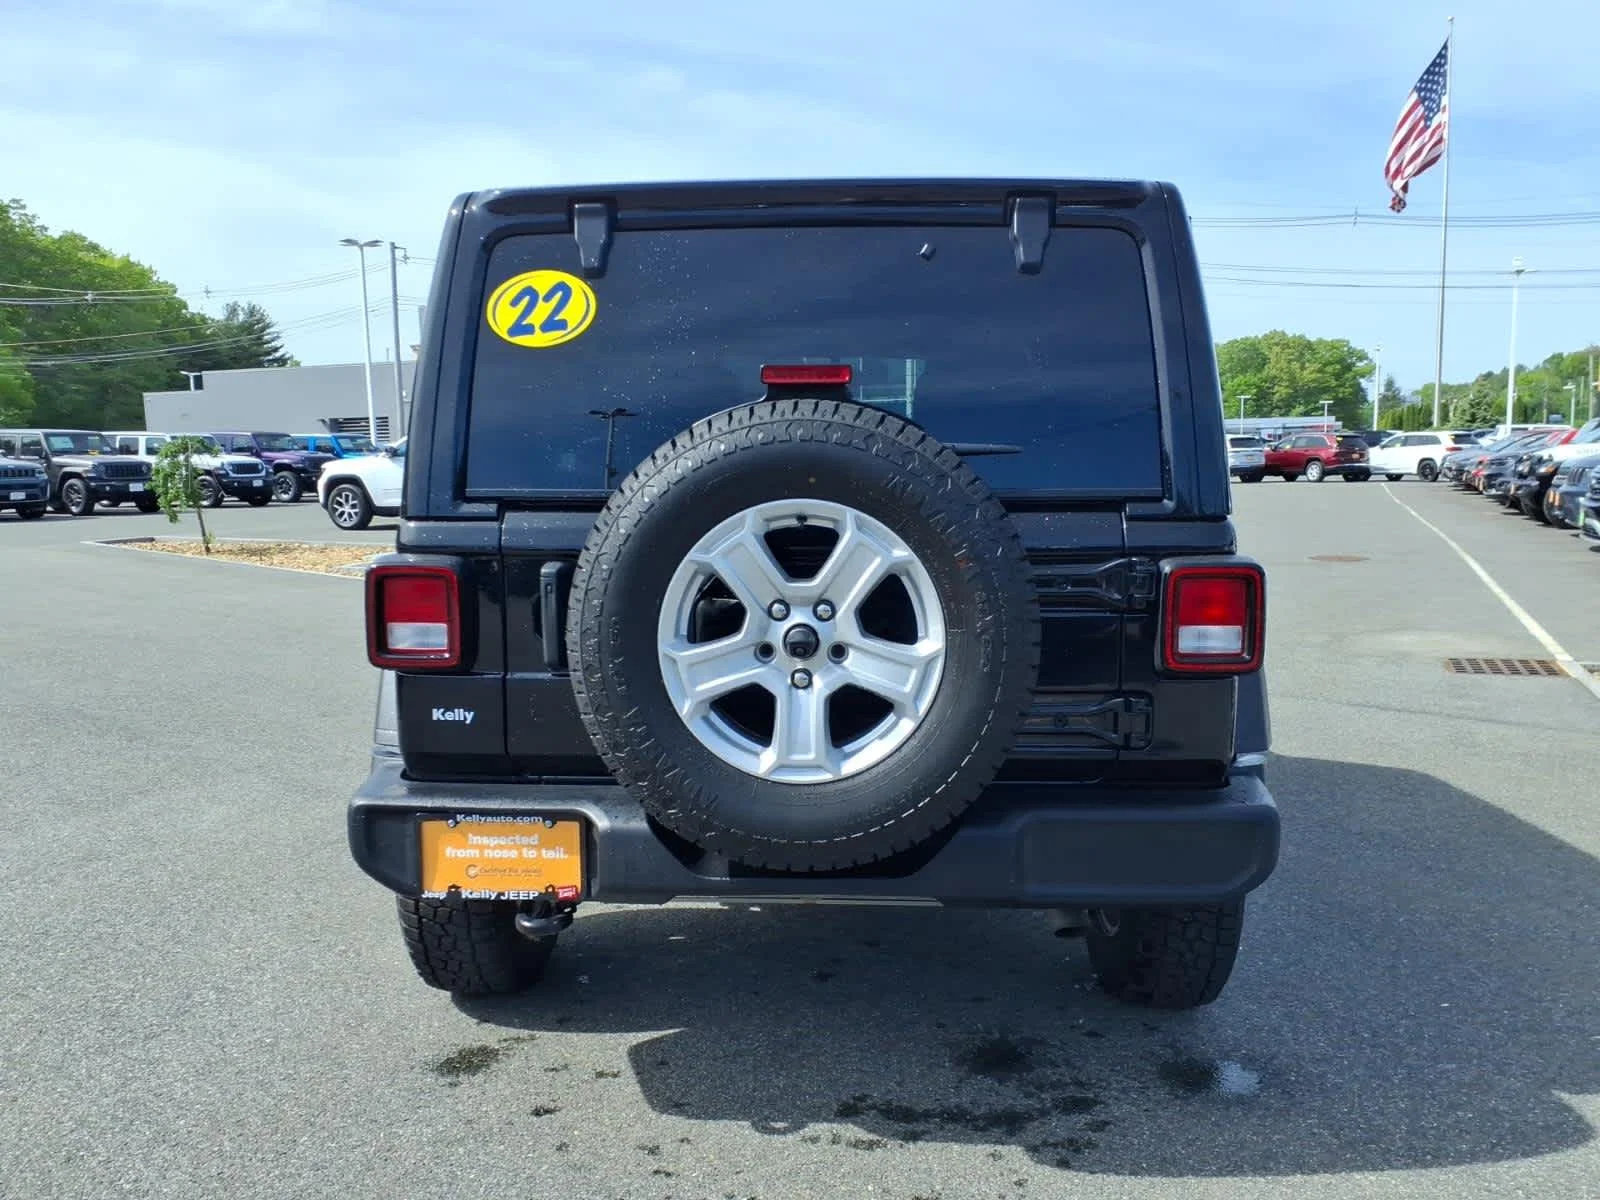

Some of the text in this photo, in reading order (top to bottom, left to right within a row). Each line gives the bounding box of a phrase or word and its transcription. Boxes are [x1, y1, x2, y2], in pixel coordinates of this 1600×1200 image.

[507, 281, 573, 338] 22
[432, 708, 475, 725] Kelly
[456, 814, 543, 825] Kellyauto.com
[468, 833, 540, 847] Inspected
[445, 847, 569, 859] from nose to tail.
[421, 890, 448, 900] Jeep
[461, 889, 540, 901] Kelly JEEP
